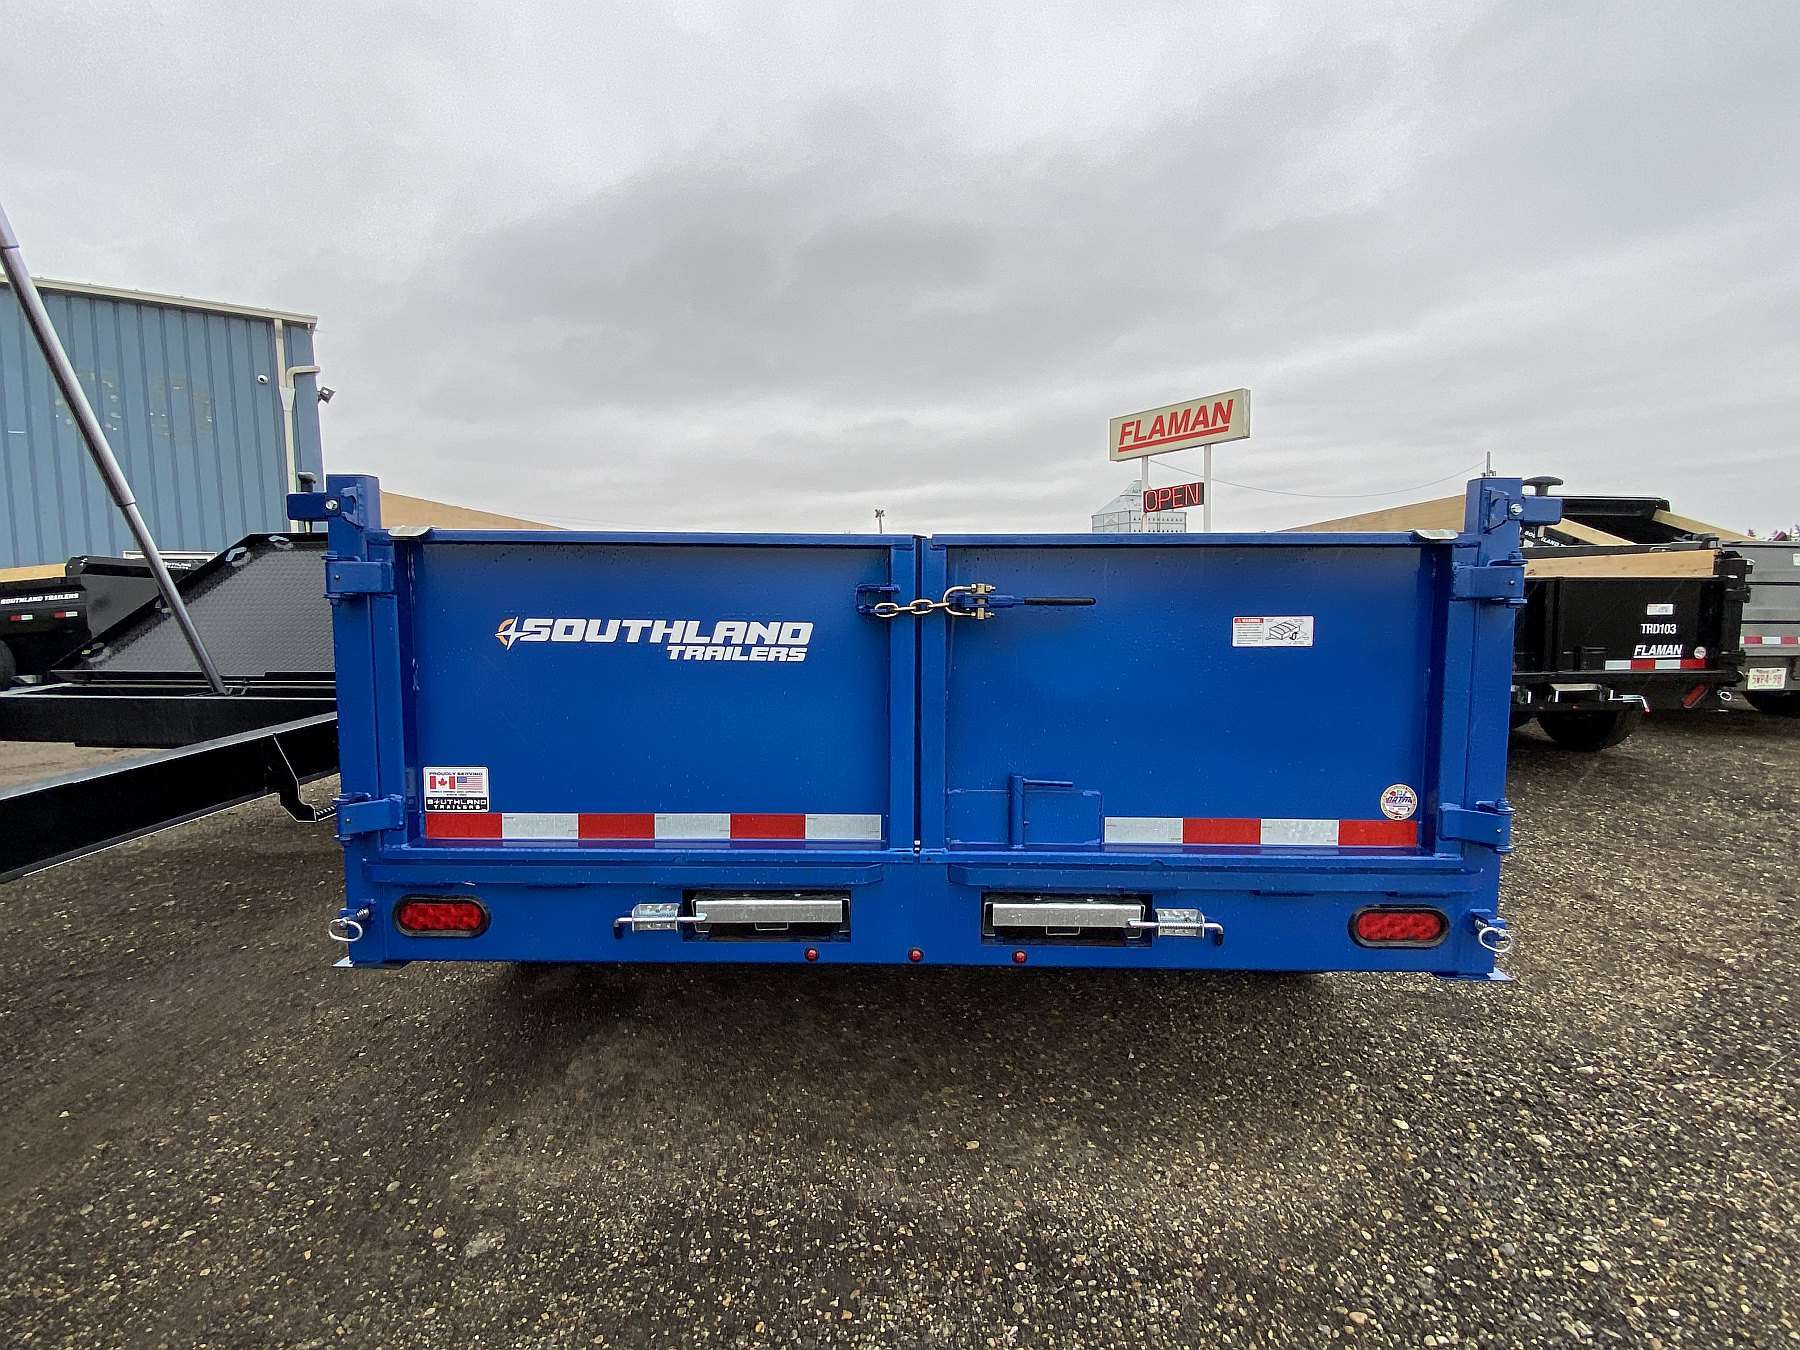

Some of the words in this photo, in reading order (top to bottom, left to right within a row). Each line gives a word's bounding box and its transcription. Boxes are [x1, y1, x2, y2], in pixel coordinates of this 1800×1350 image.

[1119, 399, 1234, 446] FLAMAN
[1145, 483, 1199, 512] OPEN
[1, 596, 43, 605] SOUTHLAND
[519, 618, 814, 646] SOUTHLAND
[1640, 623, 1677, 635] TRD103
[667, 645, 808, 662] TRAILERS
[1633, 644, 1683, 656] FLAMAN
